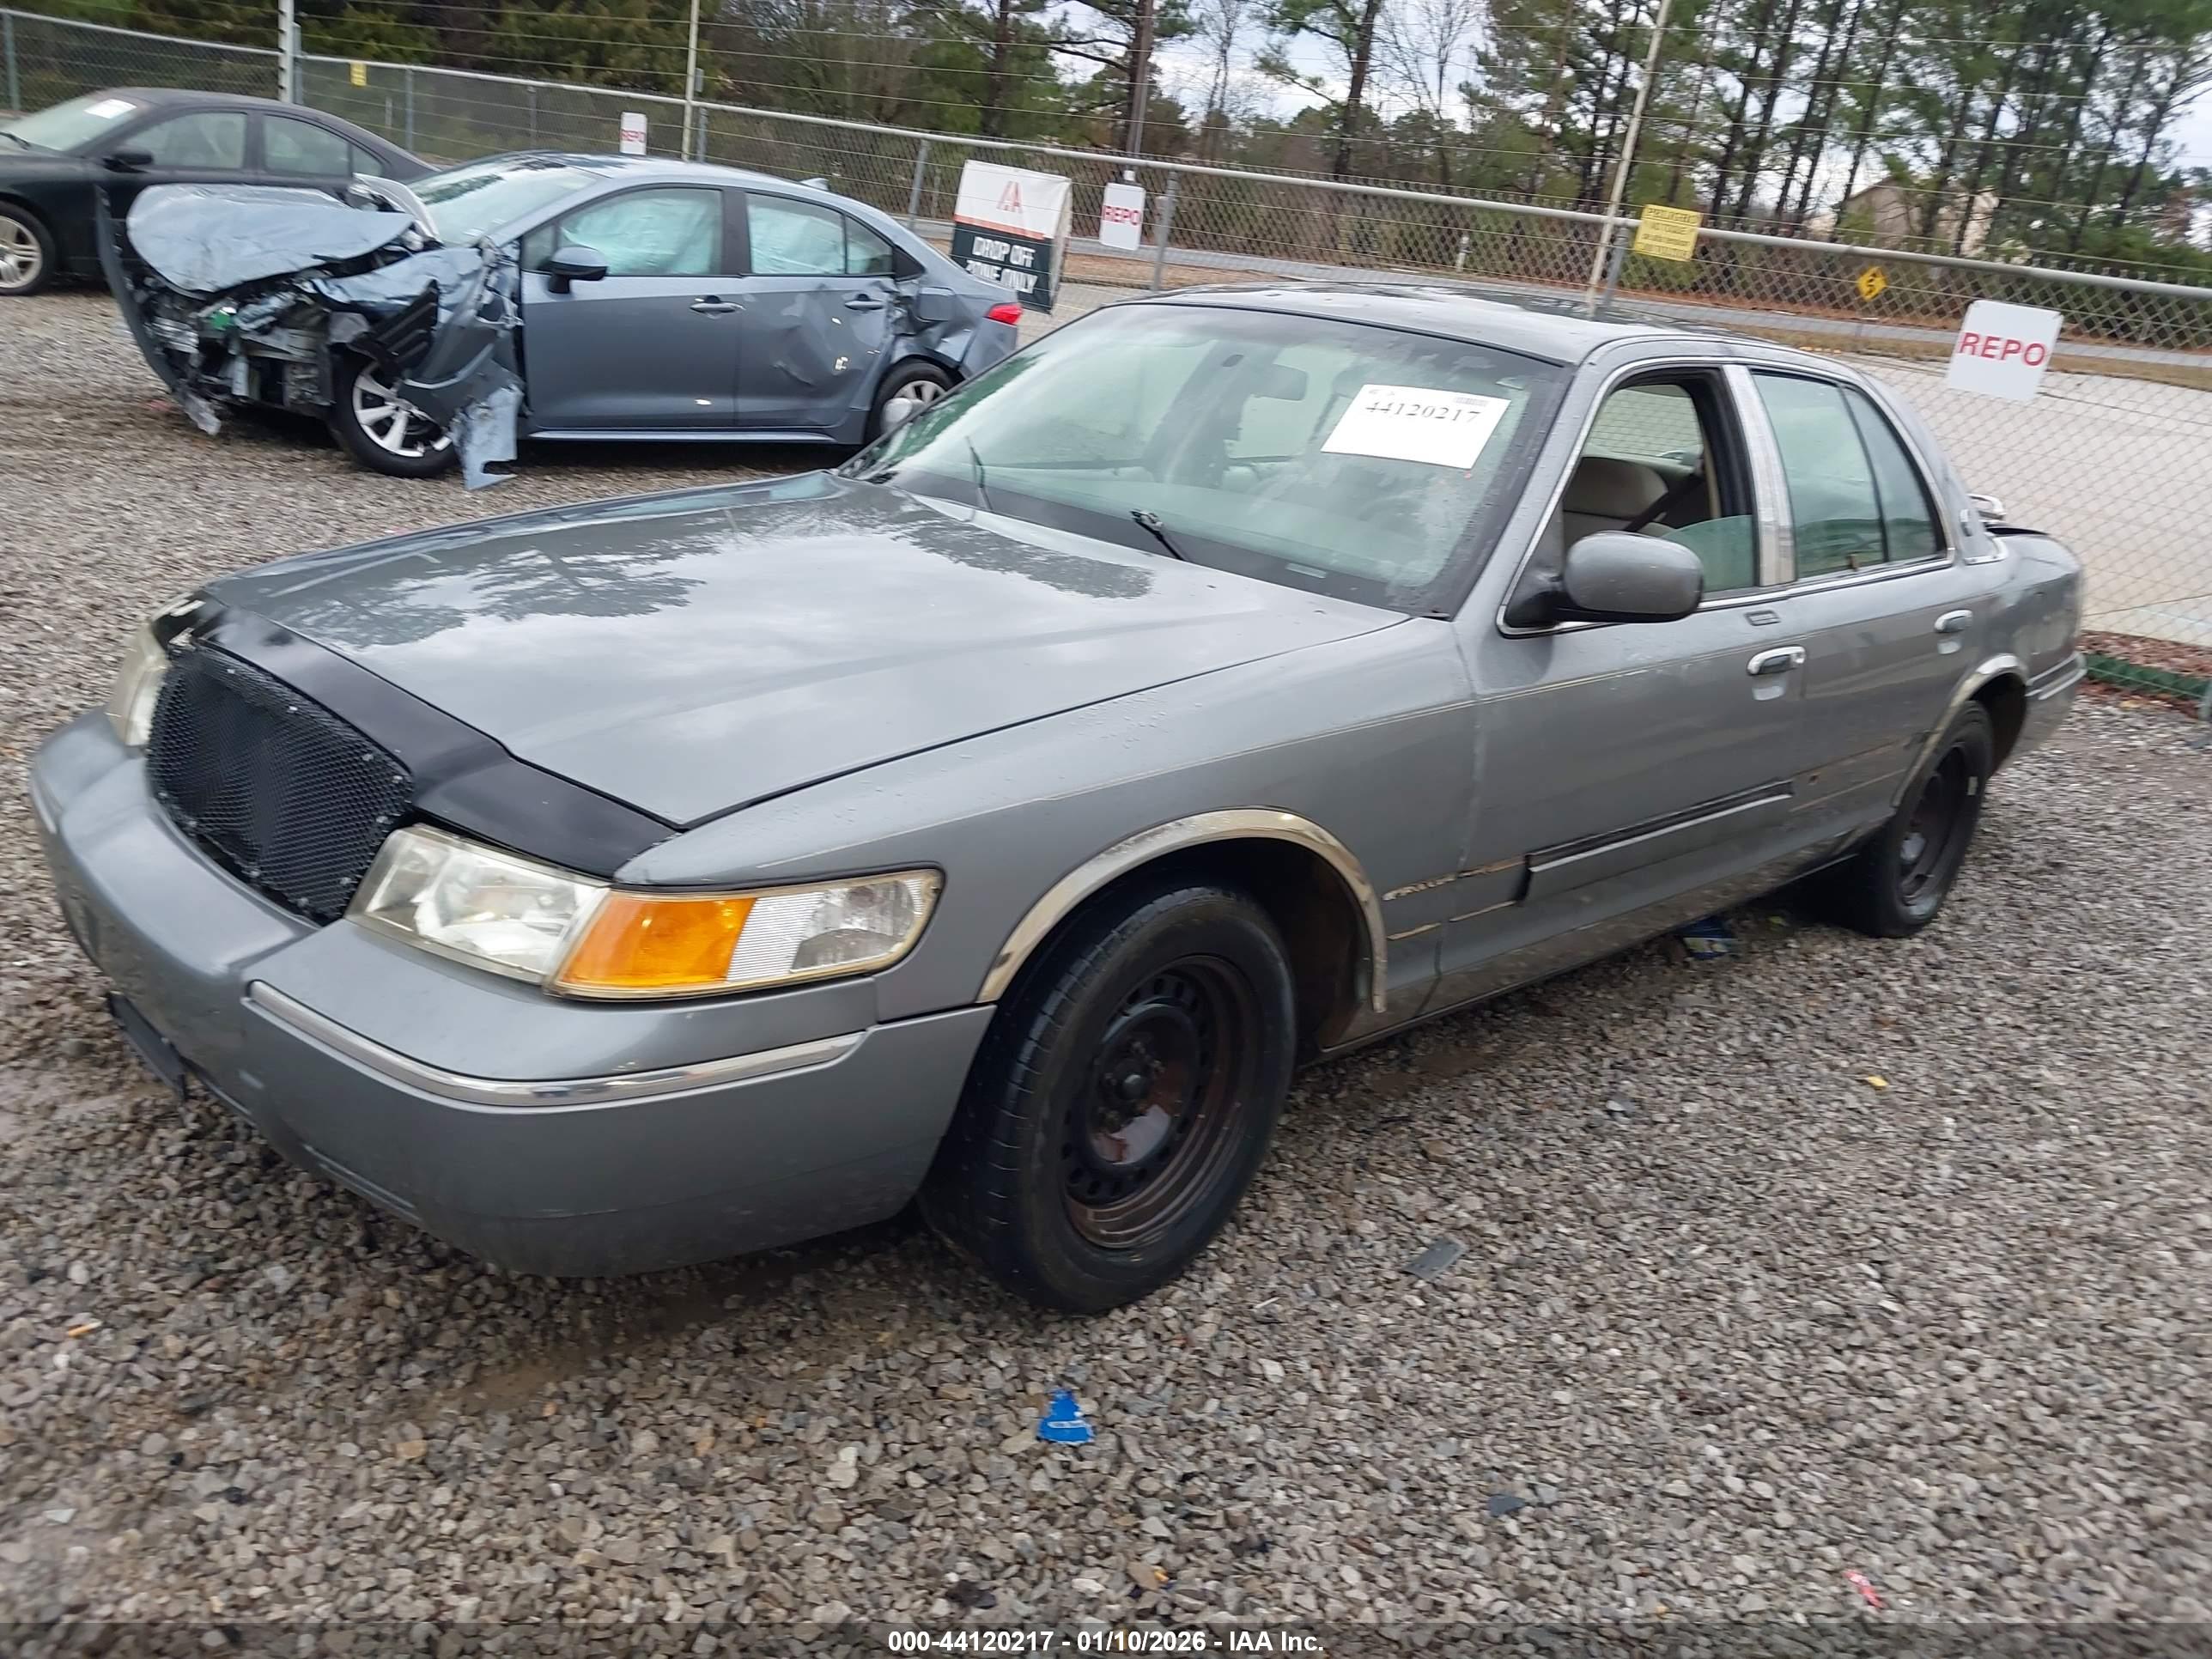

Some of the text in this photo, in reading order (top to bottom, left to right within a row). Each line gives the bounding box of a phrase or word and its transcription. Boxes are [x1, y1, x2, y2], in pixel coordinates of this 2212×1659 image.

[1102, 205, 1141, 226] REPO
[972, 235, 1036, 269] DROP OFF
[1960, 331, 2045, 367] REPO
[1364, 401, 1482, 423] 44120217
